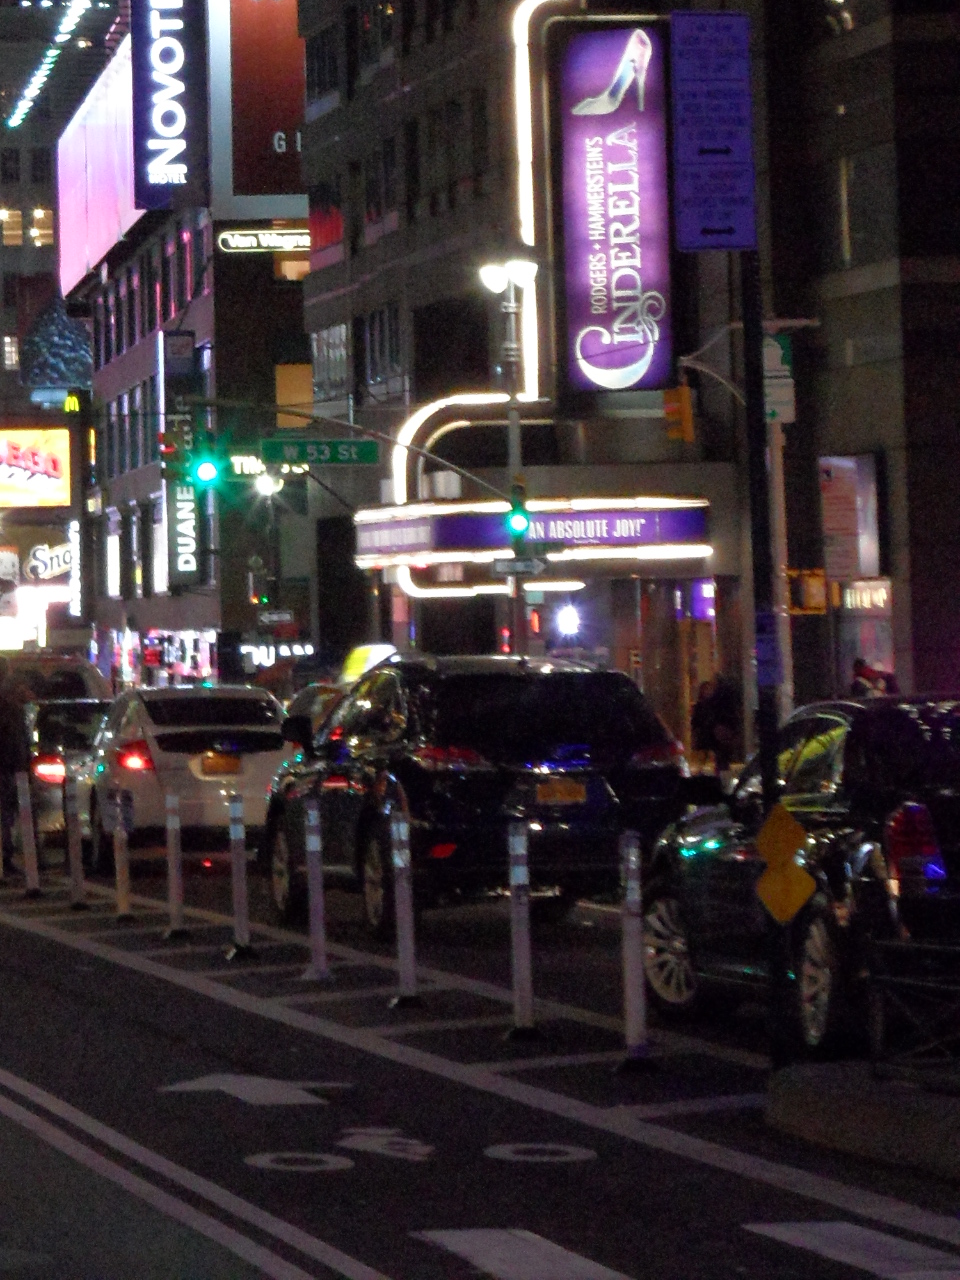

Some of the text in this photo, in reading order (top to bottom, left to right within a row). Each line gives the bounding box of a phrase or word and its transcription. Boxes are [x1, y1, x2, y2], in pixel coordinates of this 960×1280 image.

[586, 136, 605, 241] HAMMERSTEIN'S
[574, 122, 666, 389] CINDERELLA
[590, 250, 608, 315] RODGERS
[284, 441, 358, 460] W 53 St
[176, 486, 197, 572] DUANE
[528, 521, 545, 539] AN
[549, 519, 609, 539] ABSOLUTE
